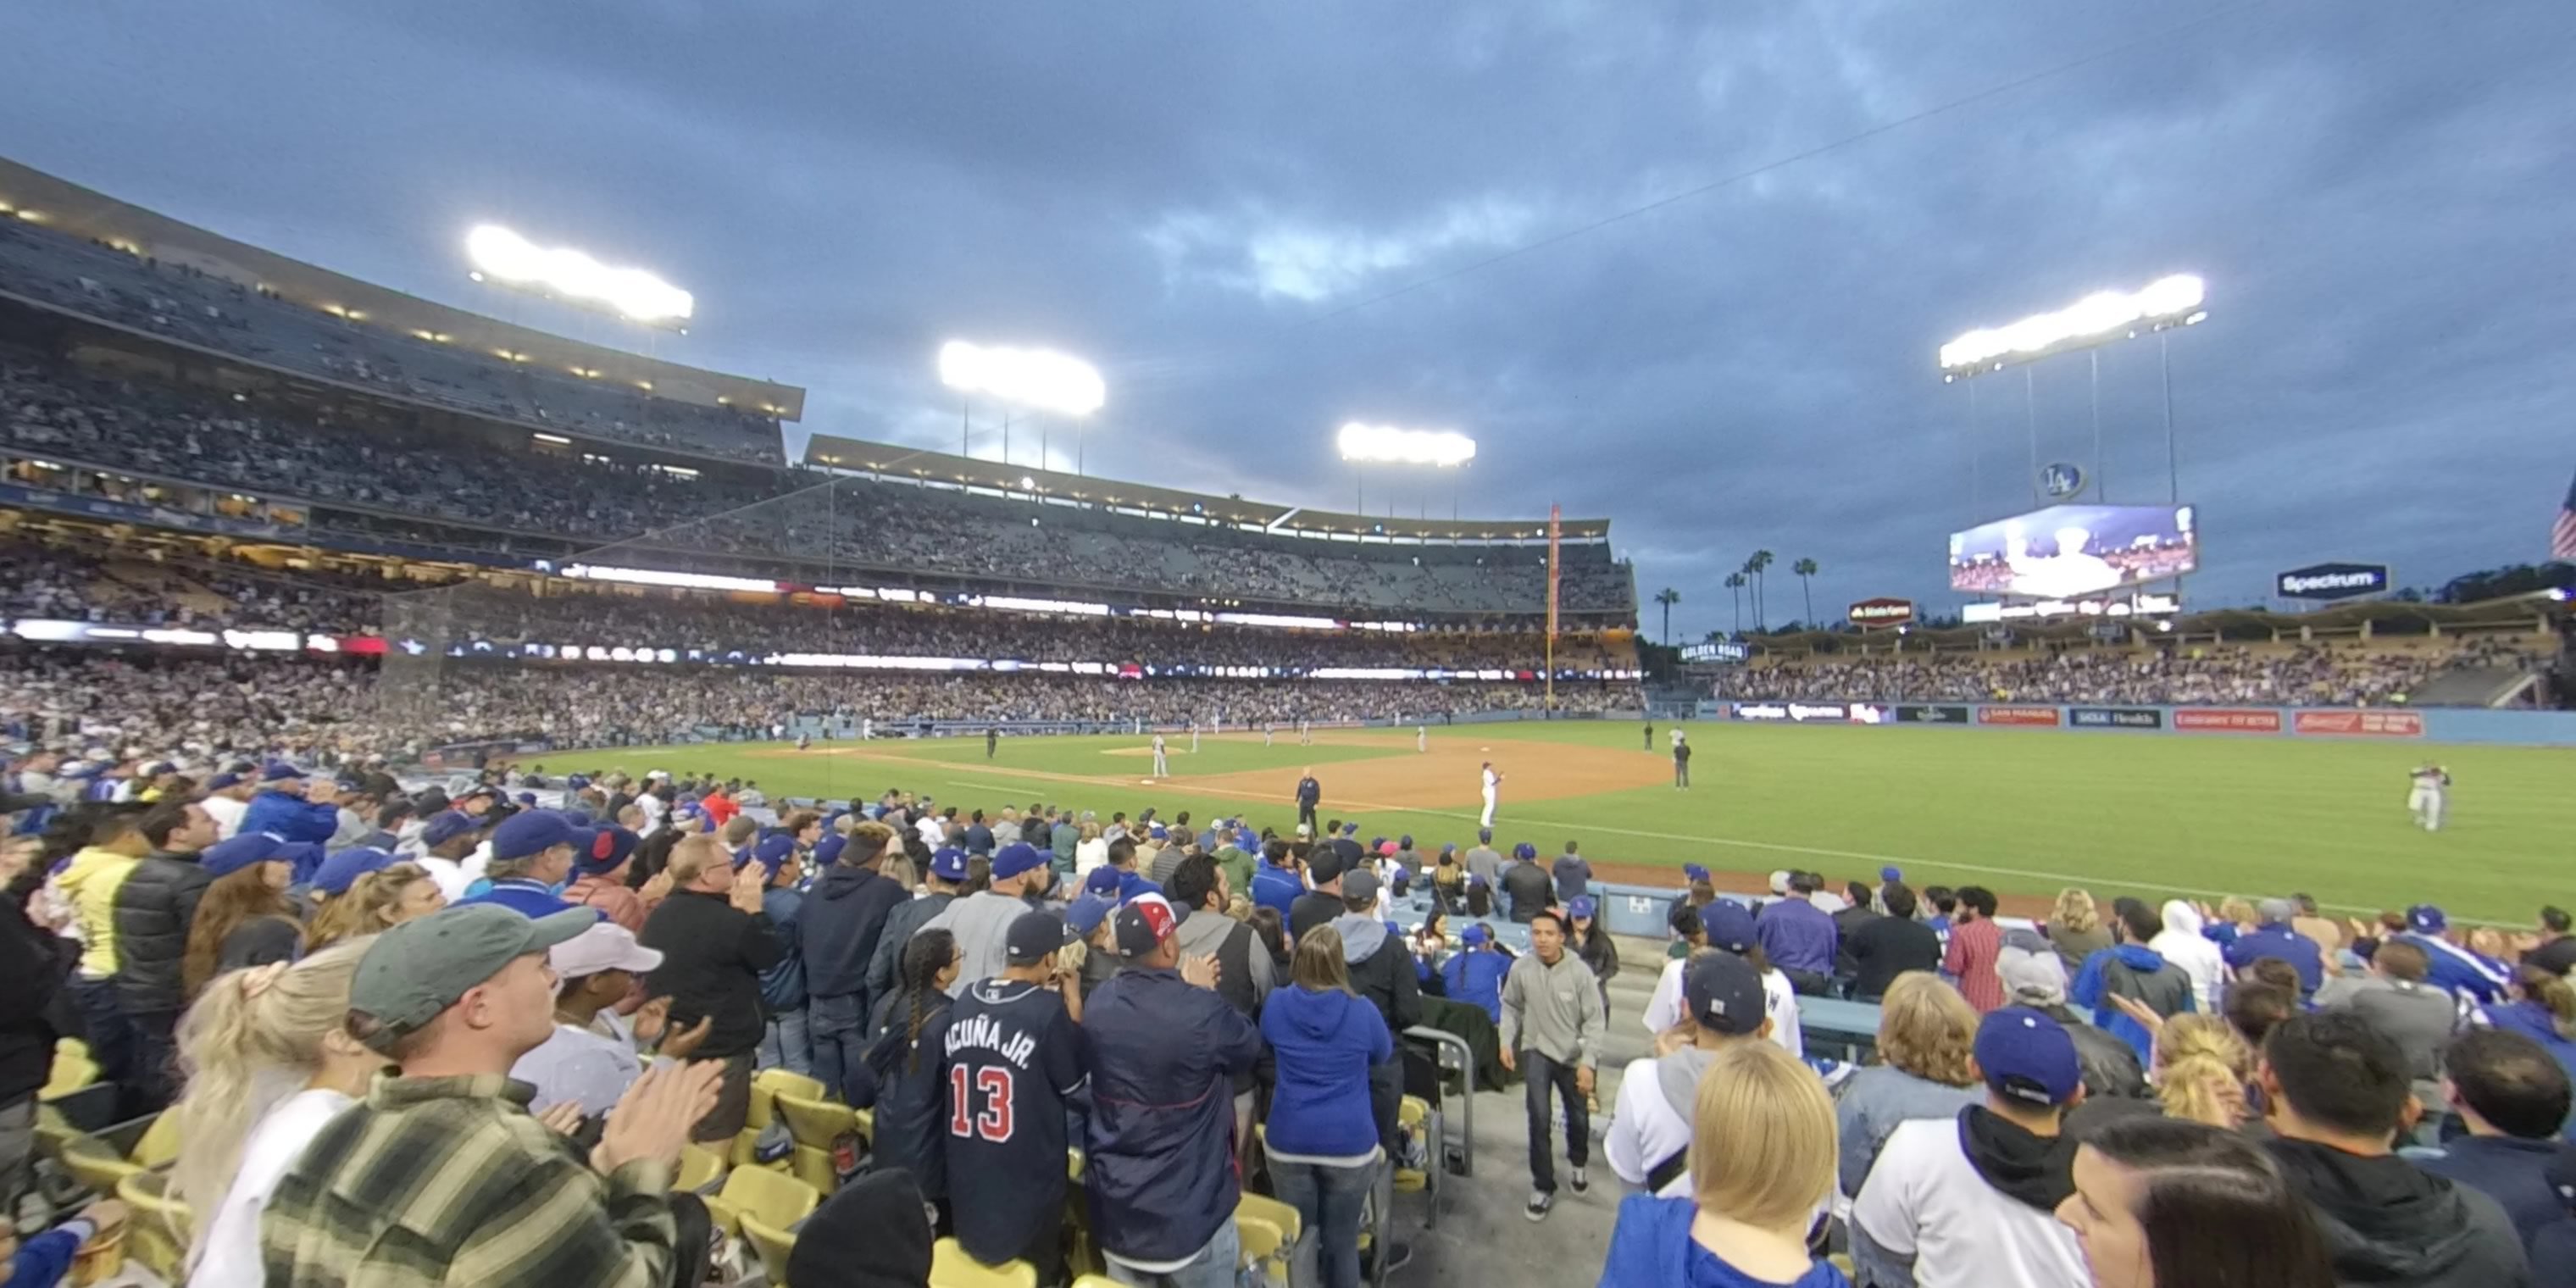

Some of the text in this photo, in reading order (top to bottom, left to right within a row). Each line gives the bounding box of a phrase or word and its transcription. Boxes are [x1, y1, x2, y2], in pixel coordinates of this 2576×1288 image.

[2047, 468, 2072, 492] LA
[2284, 573, 2373, 593] Spectrum
[1681, 644, 1716, 659] GOLDEN
[1718, 644, 1743, 658] ROAD
[945, 1013, 1035, 1070] ACUÑA JR.
[951, 1063, 1013, 1143] 13
